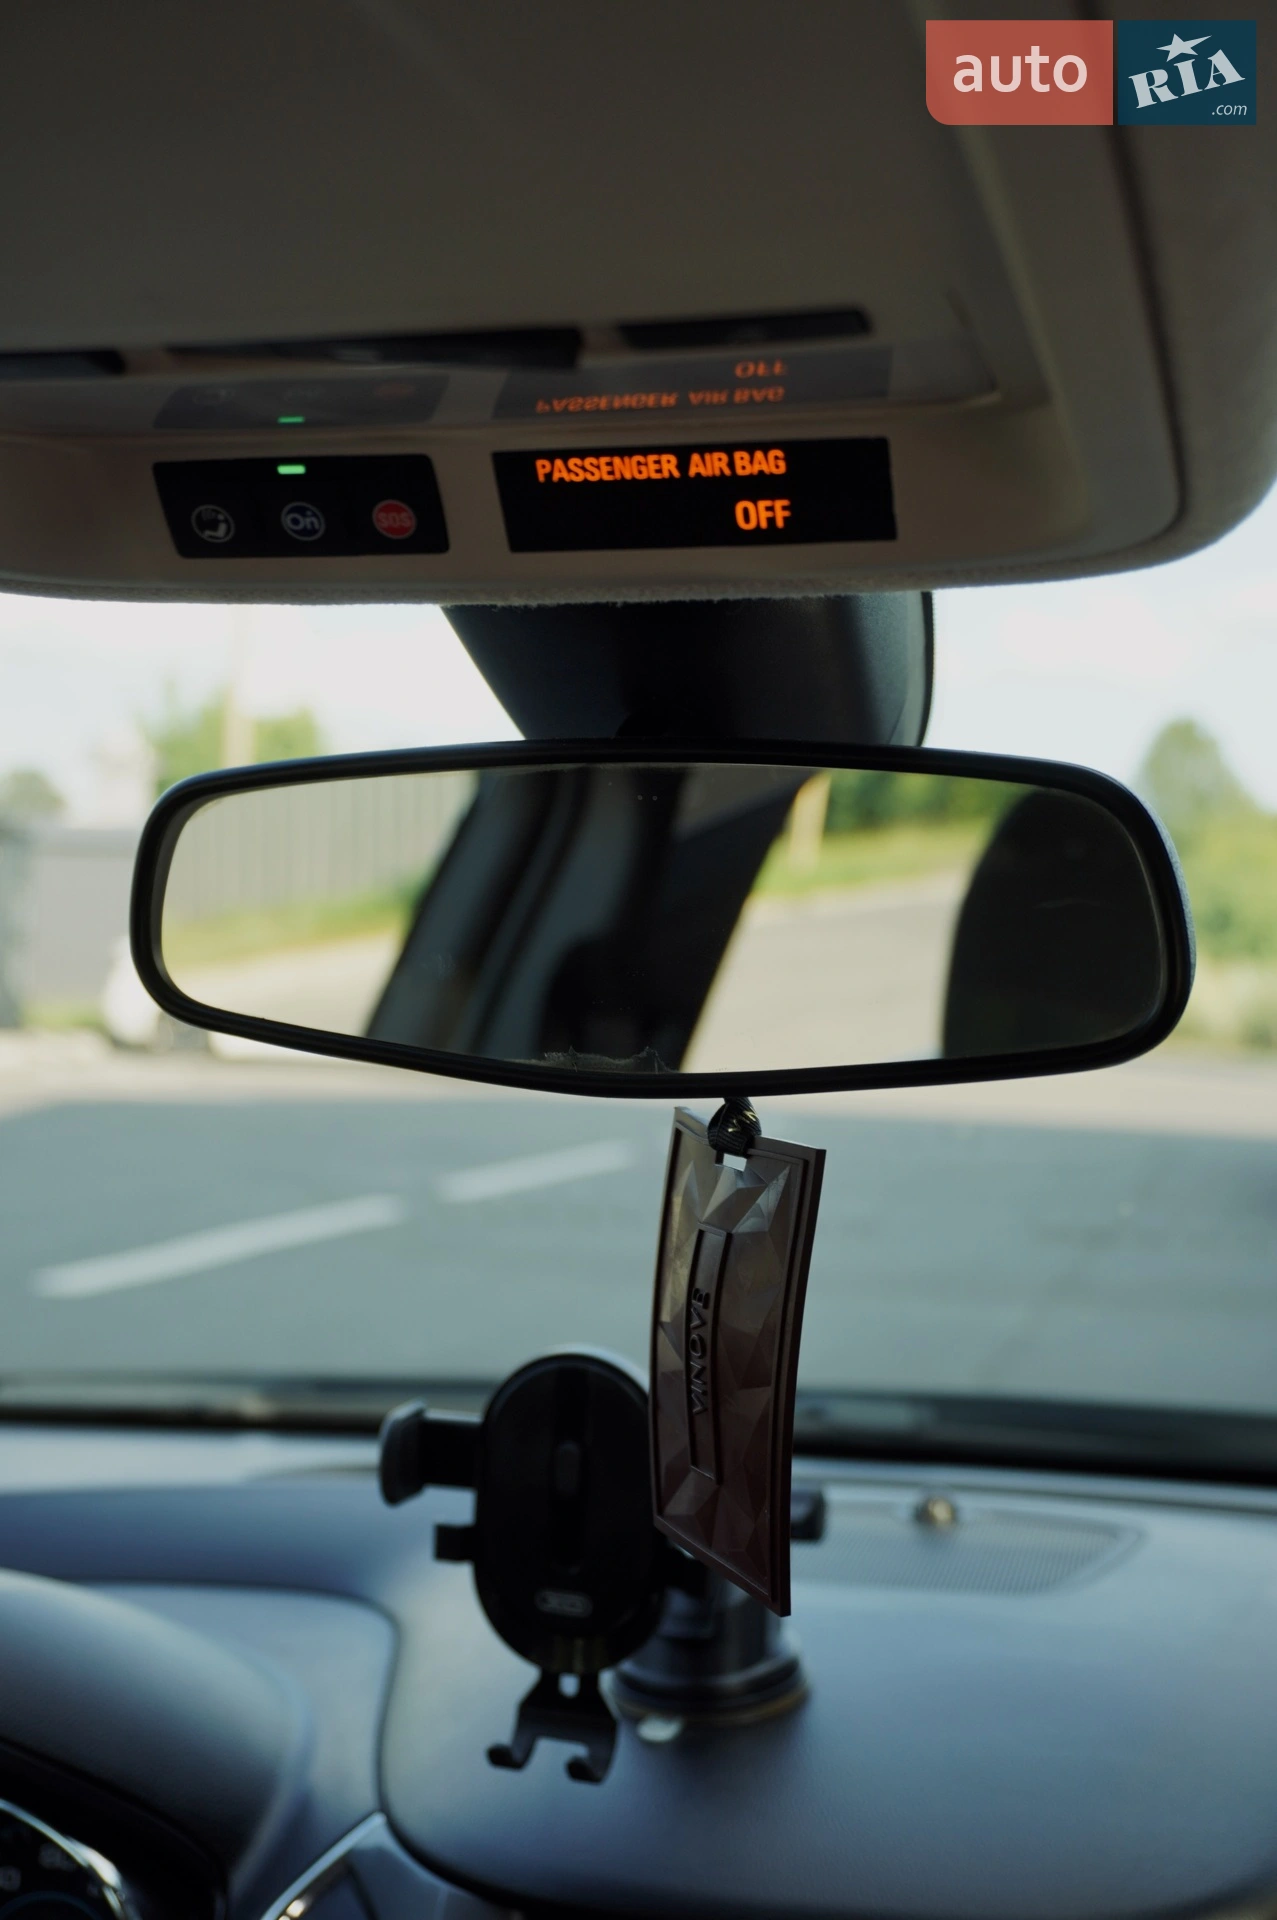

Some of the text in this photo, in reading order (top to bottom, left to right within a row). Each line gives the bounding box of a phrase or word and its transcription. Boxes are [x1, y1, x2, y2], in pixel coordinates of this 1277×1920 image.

[535, 449, 787, 483] PASSENGER AIR BAG
[286, 511, 320, 531] On
[377, 511, 411, 528] SOS
[734, 499, 792, 531] OFF
[688, 1287, 710, 1415] VINOVE
